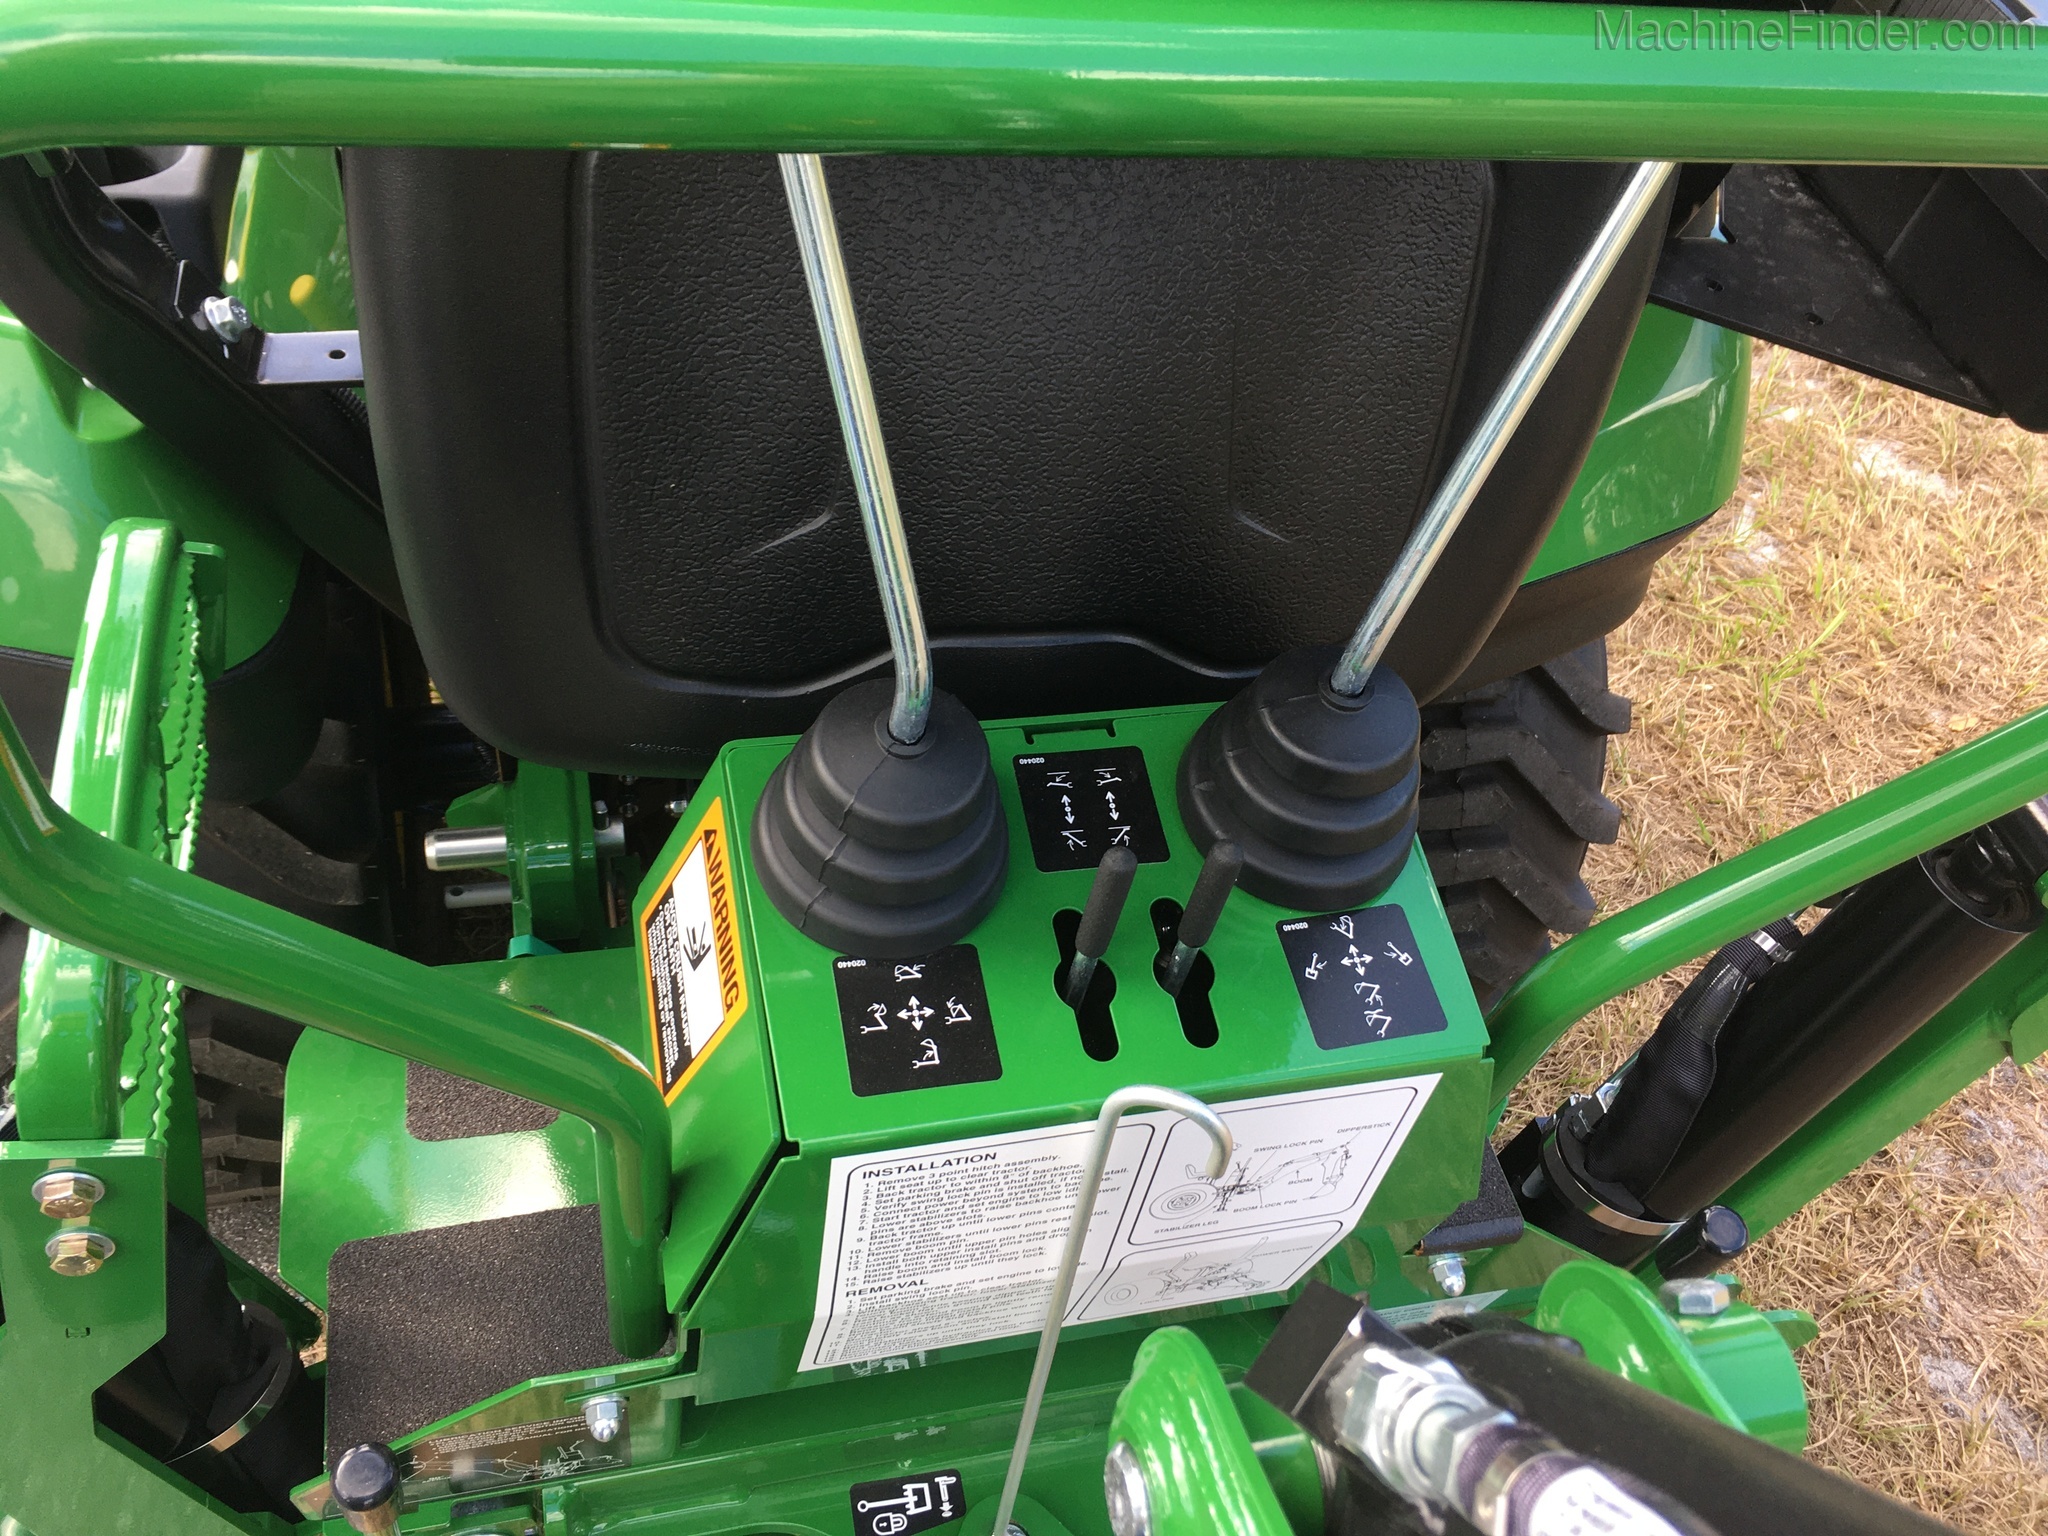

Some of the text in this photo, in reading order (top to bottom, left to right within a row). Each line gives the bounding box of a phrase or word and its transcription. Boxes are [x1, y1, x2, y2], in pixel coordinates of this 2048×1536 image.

[663, 903, 676, 975] OR DEATH
[709, 848, 739, 1013] WARNING
[667, 898, 690, 1046] AVOID CRUSH INJURY
[668, 1011, 678, 1060] controls
[1337, 1122, 1390, 1133] DIPPERSTICK
[863, 1153, 996, 1178] INSTALLATION
[878, 1175, 925, 1186] Remove
[939, 1168, 968, 1178] point
[972, 1164, 1000, 1172] hitch
[1004, 1155, 1060, 1167] assembly.
[900, 1181, 923, 1189] seat
[992, 1166, 1031, 1175] tractor.
[876, 1190, 904, 1198] Back
[909, 1184, 946, 1194] tractor
[965, 1176, 999, 1185] within
[1033, 1164, 1082, 1174] backhoe.
[897, 1191, 940, 1202] parking
[944, 1186, 976, 1194] brake
[979, 1181, 1000, 1189] and
[1004, 1177, 1028, 1185] shut
[1288, 1177, 1313, 1185] BOOM
[873, 1206, 920, 1217] Connect
[924, 1200, 958, 1210] power
[962, 1192, 1003, 1203] beyond
[1007, 1186, 1046, 1196] system
[875, 1202, 907, 1210] Verify
[911, 1195, 943, 1205] swing
[947, 1192, 970, 1200] lock
[973, 1189, 990, 1197] pin
[903, 1209, 940, 1218] tractor
[944, 1204, 964, 1212] and
[988, 1196, 1025, 1205] engine
[870, 1232, 897, 1240] Back
[901, 1227, 937, 1235] tractor
[959, 1218, 982, 1226] until
[986, 1214, 1015, 1222] lower
[1019, 1210, 1042, 1218] pins
[872, 1220, 906, 1229] Lower
[910, 1211, 967, 1223] stabilizers
[985, 1203, 1011, 1211] raise
[1015, 1196, 1061, 1206] backhoe
[919, 1219, 952, 1227] above
[868, 1243, 902, 1252] Lower
[906, 1234, 961, 1246] stabilizers
[965, 1228, 989, 1236] until
[992, 1224, 1021, 1232] lower
[1025, 1220, 1047, 1228] pins
[869, 1237, 905, 1246] tractor
[864, 1265, 901, 1273] handle
[929, 1253, 975, 1263] retaining
[979, 1247, 1001, 1255] slot.
[865, 1259, 898, 1268] Install
[930, 1250, 961, 1258] upper
[964, 1243, 996, 1252] install
[866, 1254, 899, 1263] Lower
[903, 1249, 934, 1257] boom
[965, 1239, 996, 1247] upper
[867, 1247, 911, 1257] Remove
[915, 1242, 945, 1250] boom
[864, 1271, 893, 1279] Raise
[954, 1255, 986, 1264] install
[896, 1267, 950, 1279] stabilizers
[846, 1279, 927, 1297] REMOVAL
[880, 1289, 920, 1299] parking
[997, 1271, 1031, 1279] engine
[859, 1298, 891, 1307] Install
[895, 1293, 925, 1301] swing
